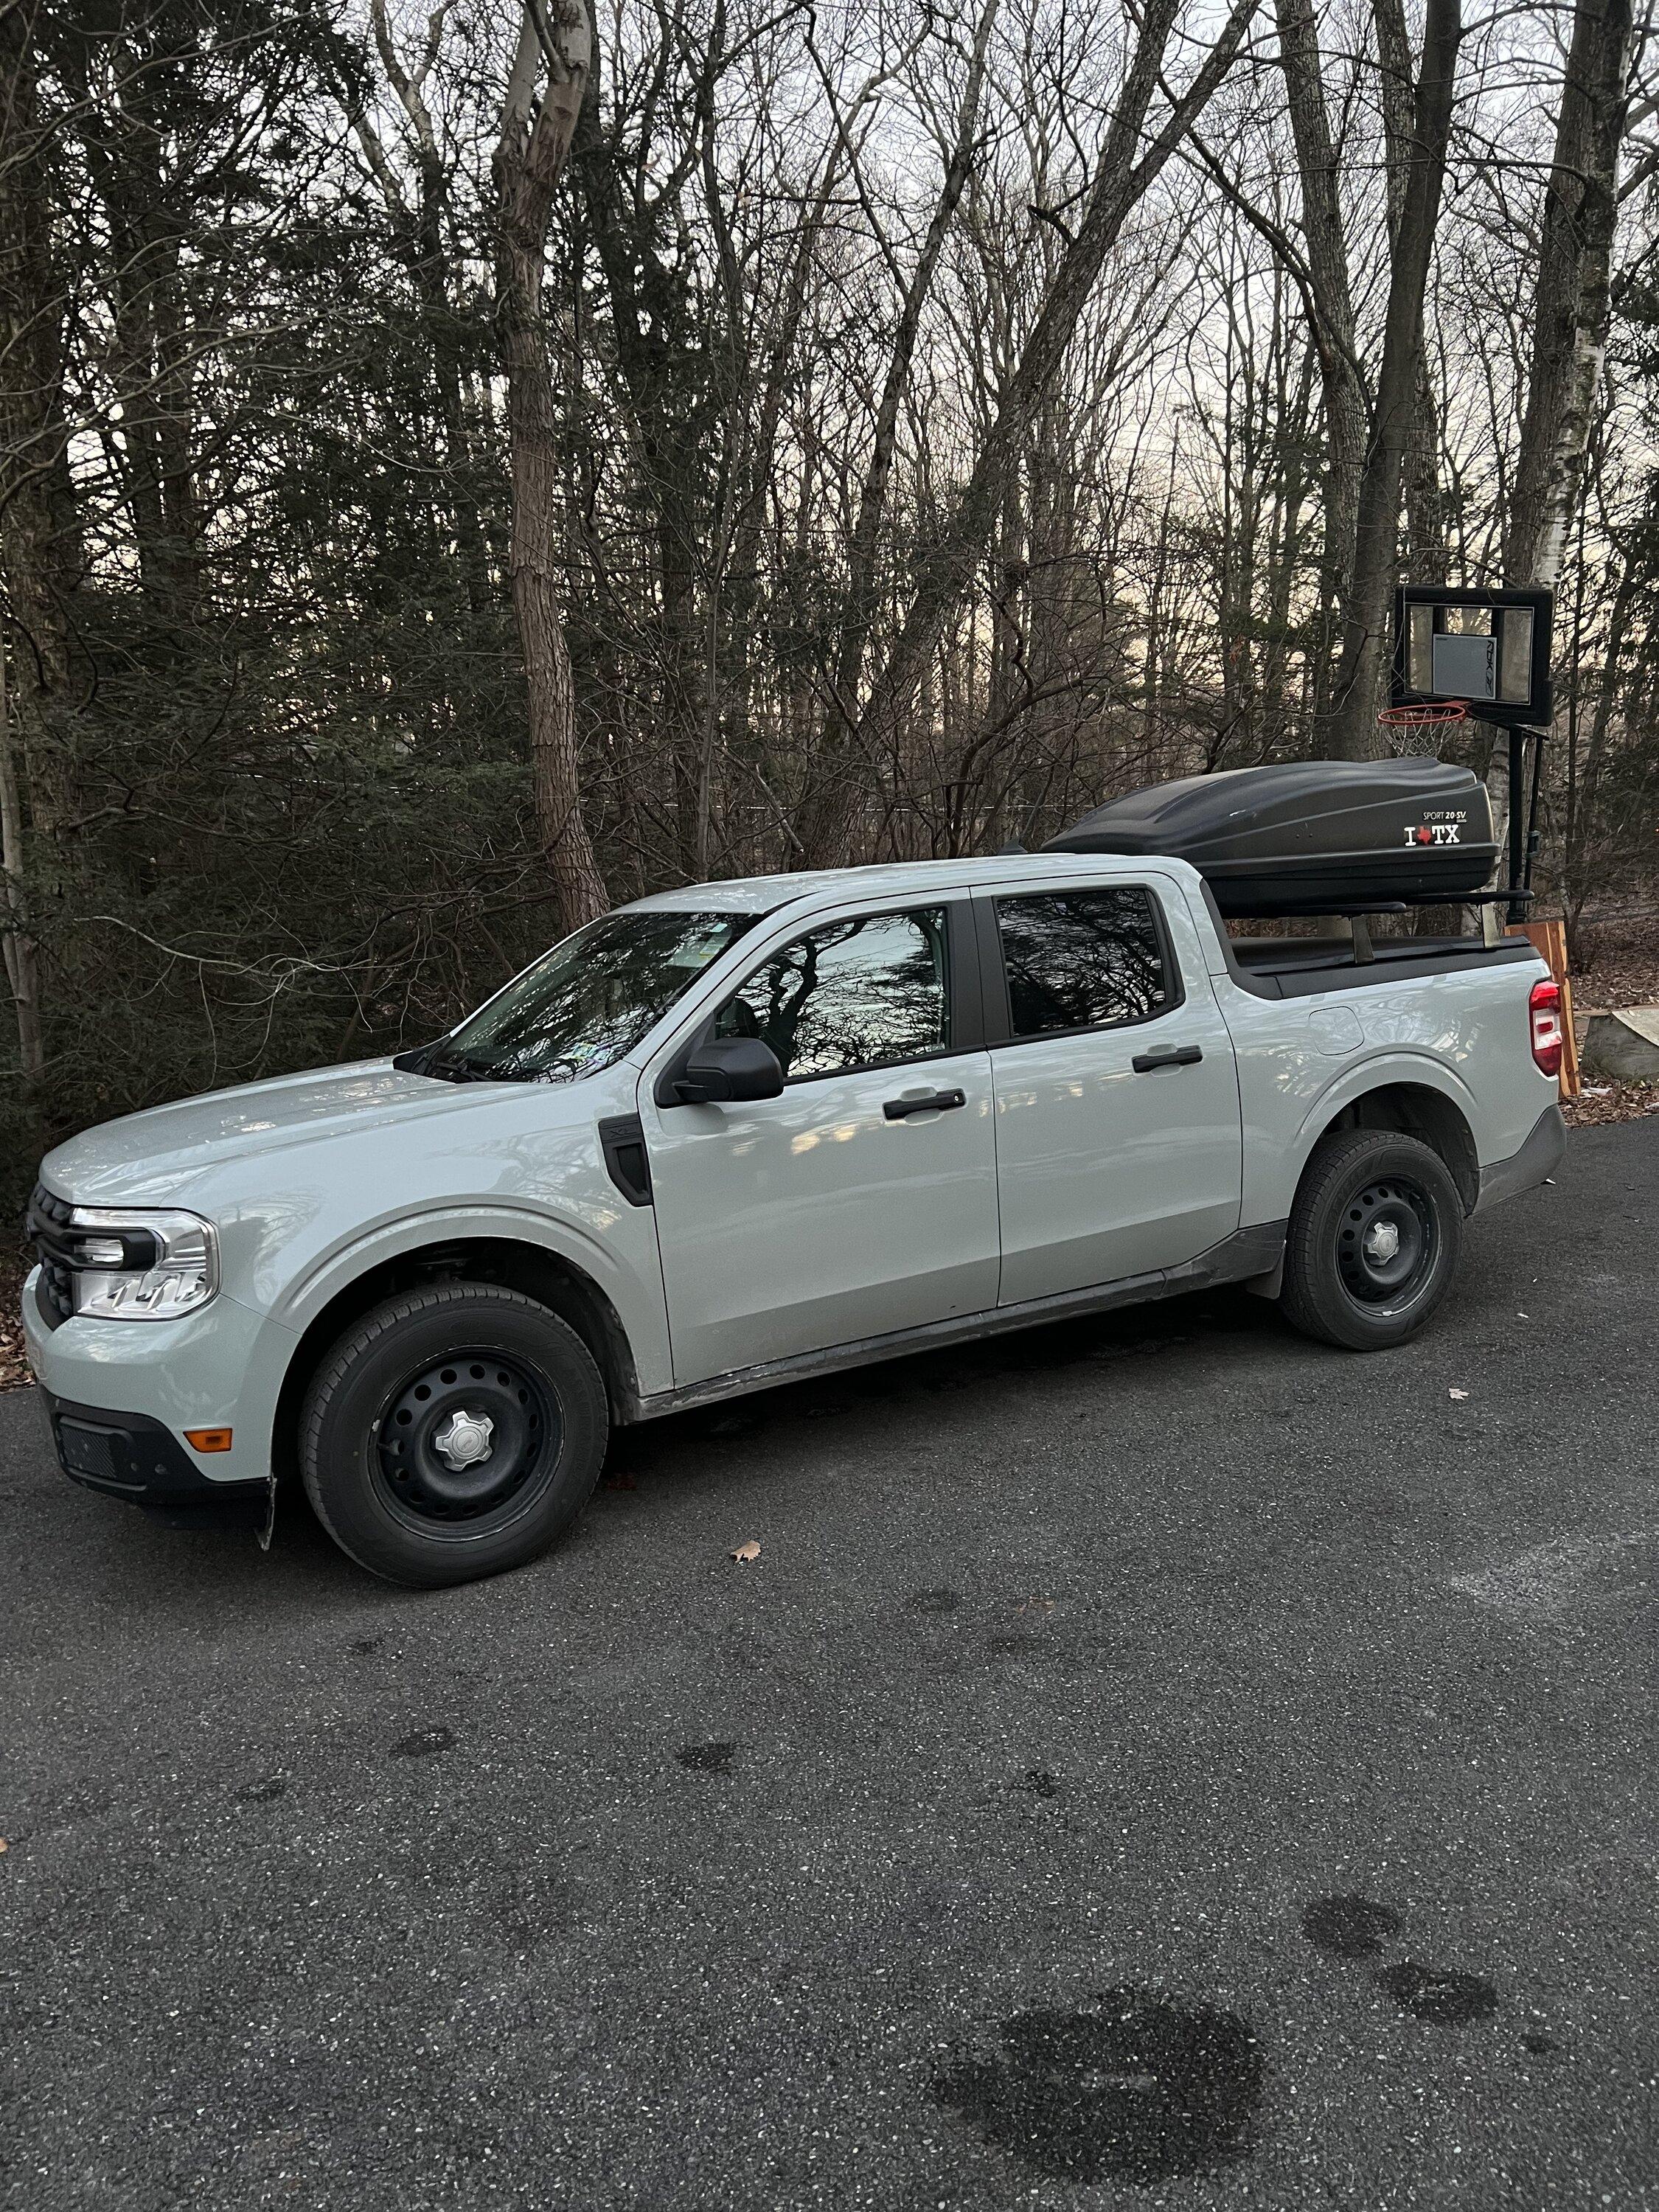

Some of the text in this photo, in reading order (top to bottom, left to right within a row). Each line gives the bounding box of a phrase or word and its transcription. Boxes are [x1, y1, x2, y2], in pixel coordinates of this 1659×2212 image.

[1423, 812, 1444, 821] SPORT
[1404, 824, 1460, 846] I TX
